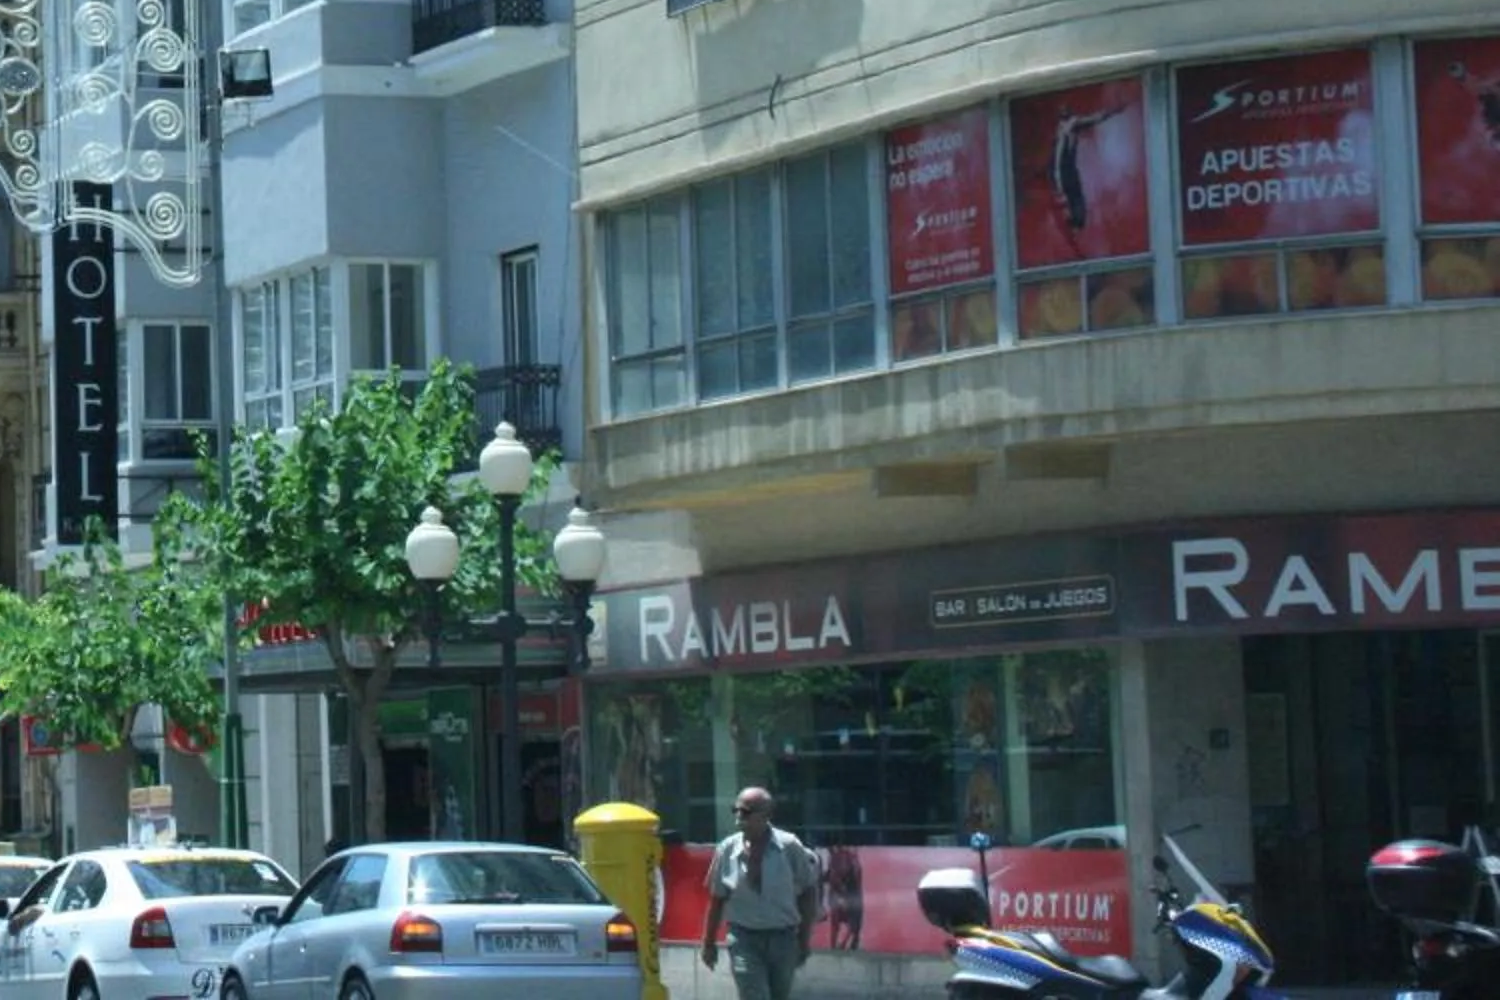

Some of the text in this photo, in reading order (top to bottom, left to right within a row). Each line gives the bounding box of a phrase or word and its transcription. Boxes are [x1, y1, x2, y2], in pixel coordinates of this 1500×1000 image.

[1191, 79, 1360, 122] SPORTIUM
[1201, 138, 1356, 175] APUESTAS
[1187, 171, 1372, 211] DEPORTIVAS
[66, 193, 107, 502] HOTEL
[935, 600, 965, 617] BAR
[1043, 586, 1107, 609] JUEGOS
[638, 594, 851, 663] RAMBLA
